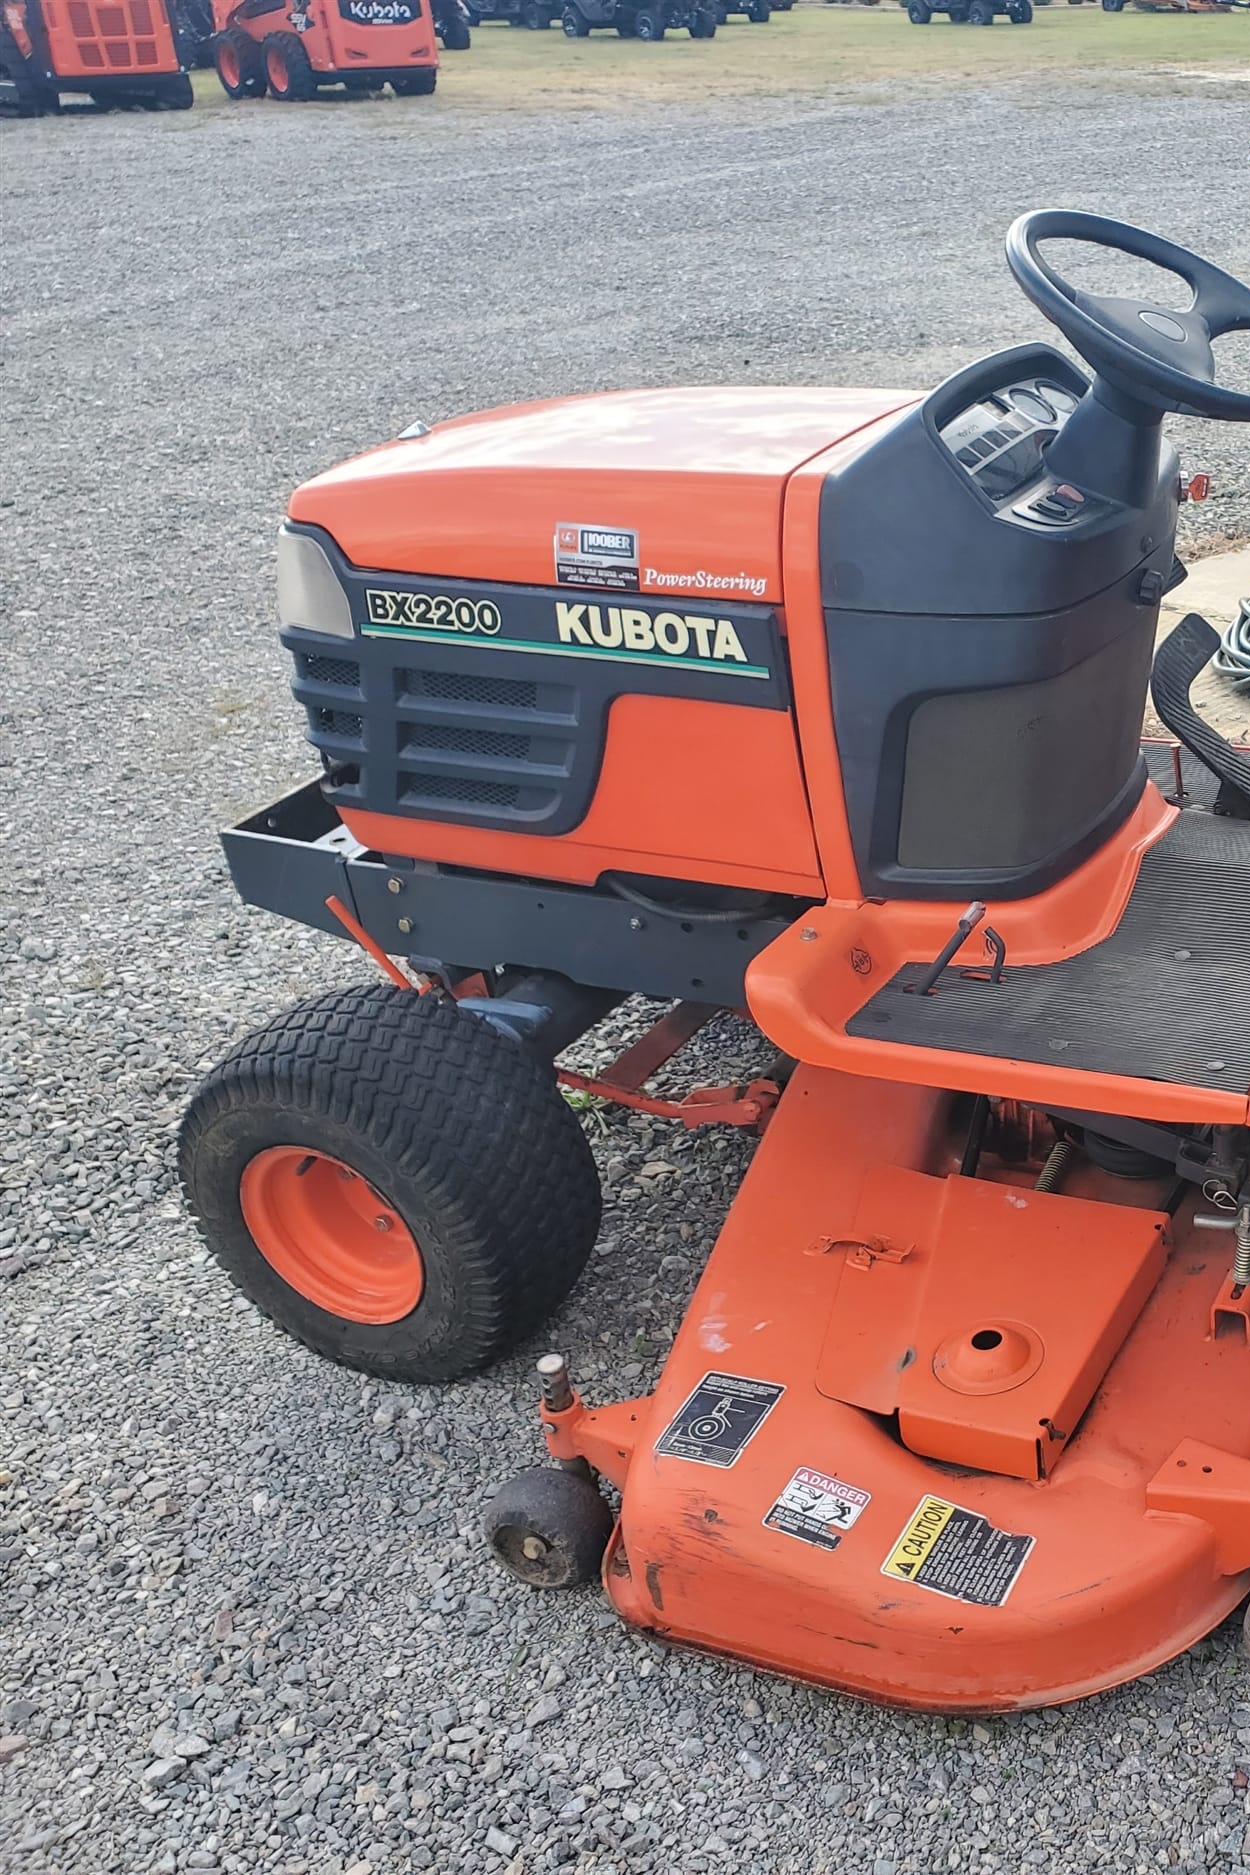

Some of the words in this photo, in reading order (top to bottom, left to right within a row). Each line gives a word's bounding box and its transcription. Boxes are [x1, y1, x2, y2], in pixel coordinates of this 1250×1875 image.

[350, 1, 411, 18] Kubota
[643, 567, 768, 596] PowerSteering
[366, 589, 501, 636] BX2200
[555, 601, 748, 662] KUBOTA
[809, 1474, 867, 1505] DANGER
[902, 1501, 949, 1557] CAUTION
